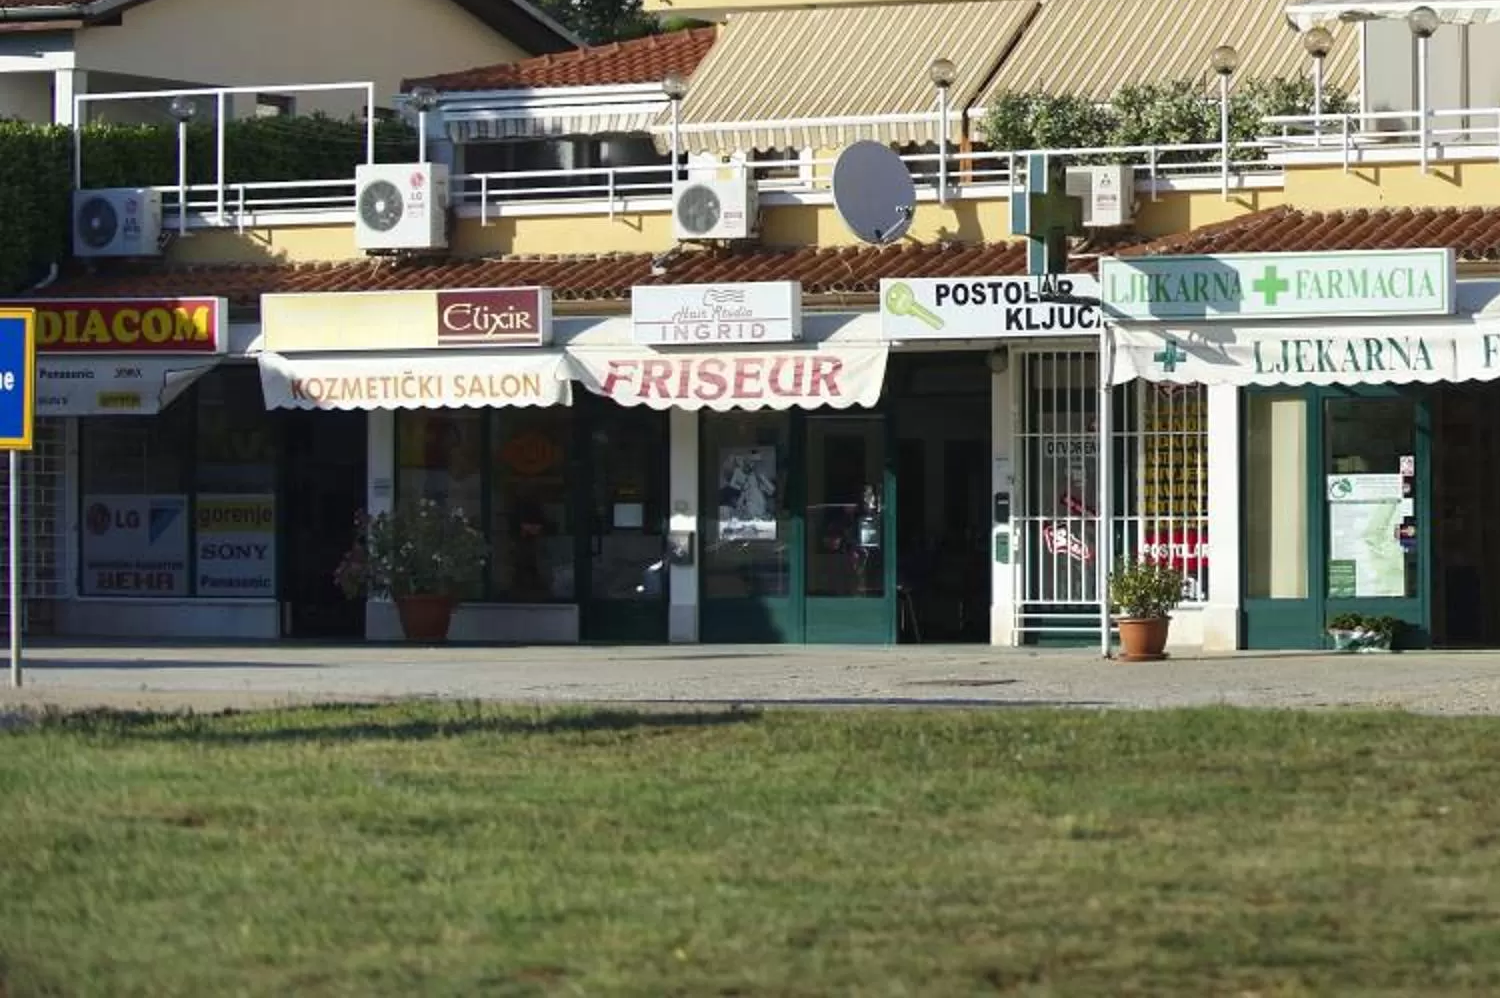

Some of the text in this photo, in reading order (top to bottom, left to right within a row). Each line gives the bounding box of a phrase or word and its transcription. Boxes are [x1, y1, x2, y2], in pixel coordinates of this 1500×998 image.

[1109, 267, 1436, 304] LJEKARNA FARMACIA
[661, 322, 765, 341] INGRID
[1253, 336, 1435, 374] LJEKARNA
[291, 370, 542, 401] KOZMETIČKI SALON
[601, 355, 843, 401] FRISEUR
[115, 509, 141, 529] LG
[199, 505, 272, 528] gorenje
[200, 544, 268, 560] SONY
[201, 574, 272, 589] Panasonic
